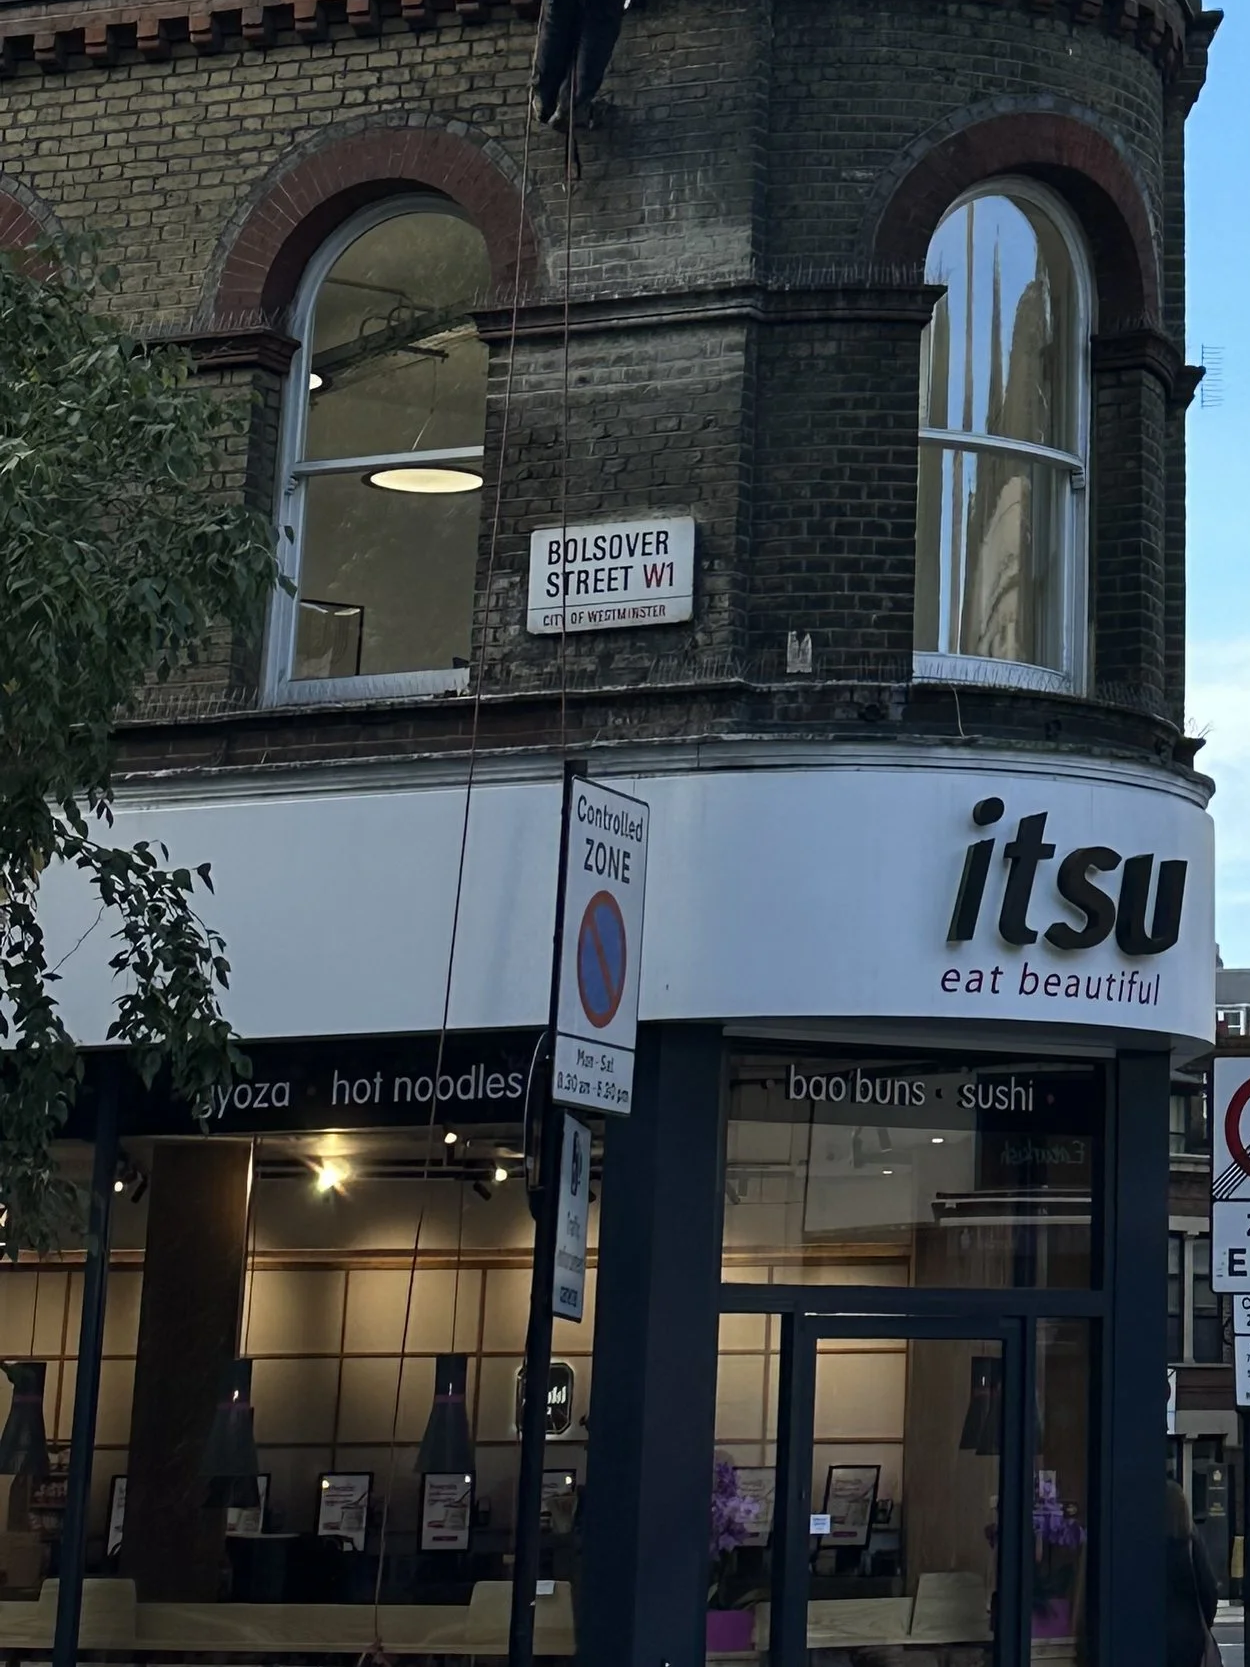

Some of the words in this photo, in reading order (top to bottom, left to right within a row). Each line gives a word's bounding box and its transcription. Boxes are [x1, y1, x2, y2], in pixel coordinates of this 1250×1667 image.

[548, 531, 669, 565] BOLSOVER
[546, 566, 633, 598] STREET
[643, 562, 674, 589] W1
[571, 611, 584, 625] OF
[588, 605, 666, 623] WESTMINSTER
[577, 794, 643, 843] Controlled
[584, 838, 631, 884] ZONE
[946, 797, 1188, 955] itsu
[941, 966, 1004, 994] eat
[1019, 962, 1160, 1006] beautiful
[332, 1070, 383, 1105] hot
[394, 1063, 523, 1103] noodles
[789, 1064, 847, 1102] bao
[855, 1068, 926, 1105] buns
[961, 1076, 1034, 1111] sushi
